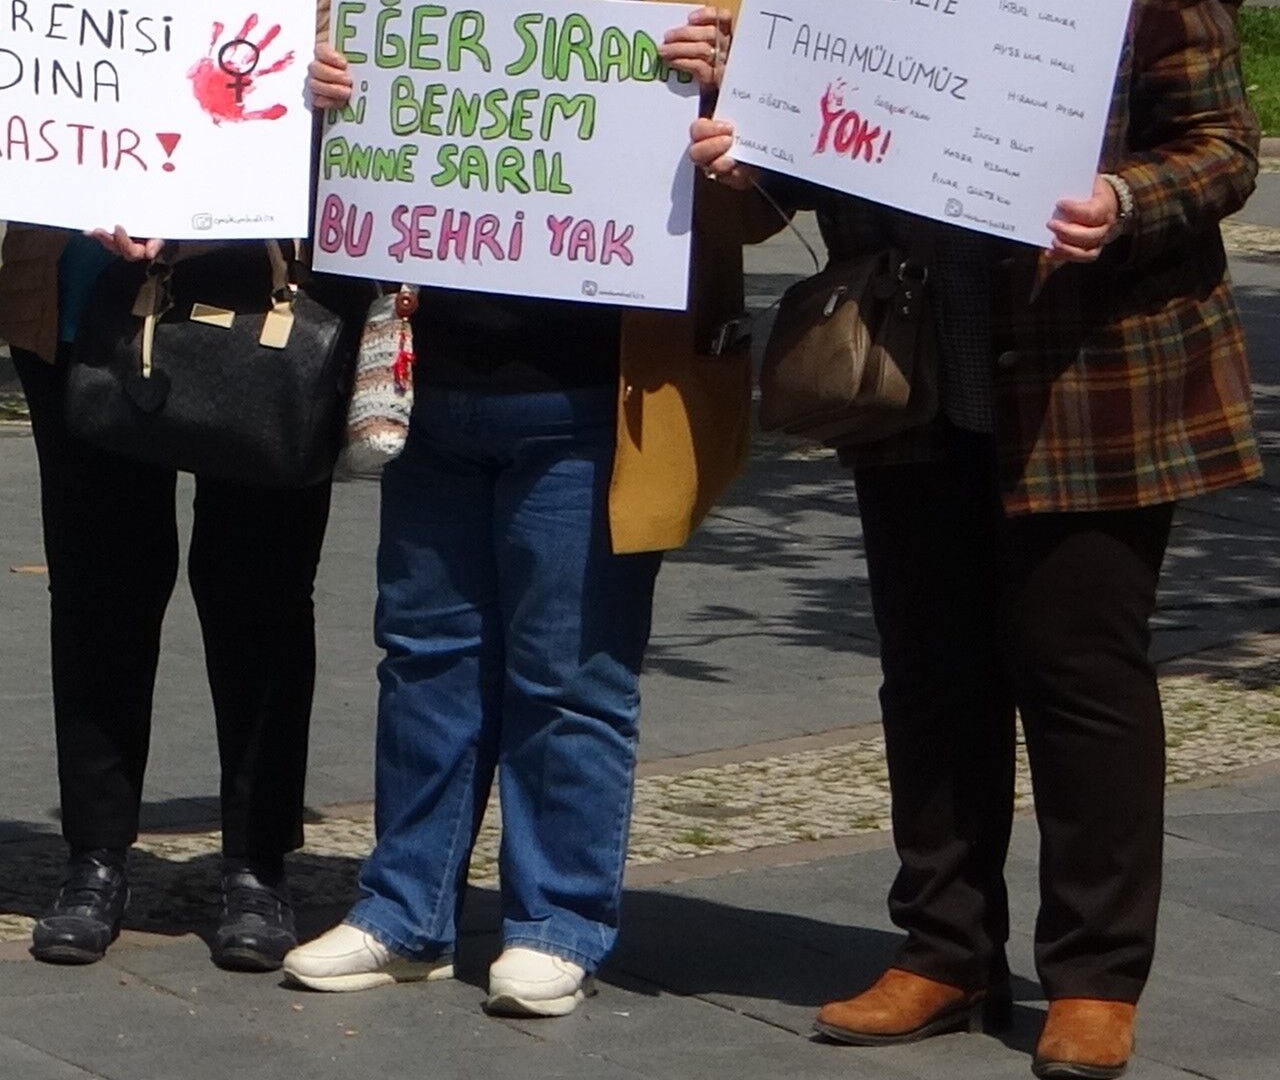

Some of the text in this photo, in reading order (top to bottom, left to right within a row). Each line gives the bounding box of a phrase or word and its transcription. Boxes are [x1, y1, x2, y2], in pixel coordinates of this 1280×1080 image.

[760, 11, 969, 100] TAHAMÜLÜMÜZ
[389, 75, 597, 141] BENSEM
[324, 136, 573, 195] ANNE SARIL
[318, 193, 634, 266] BU ŞEHRİ YAK
